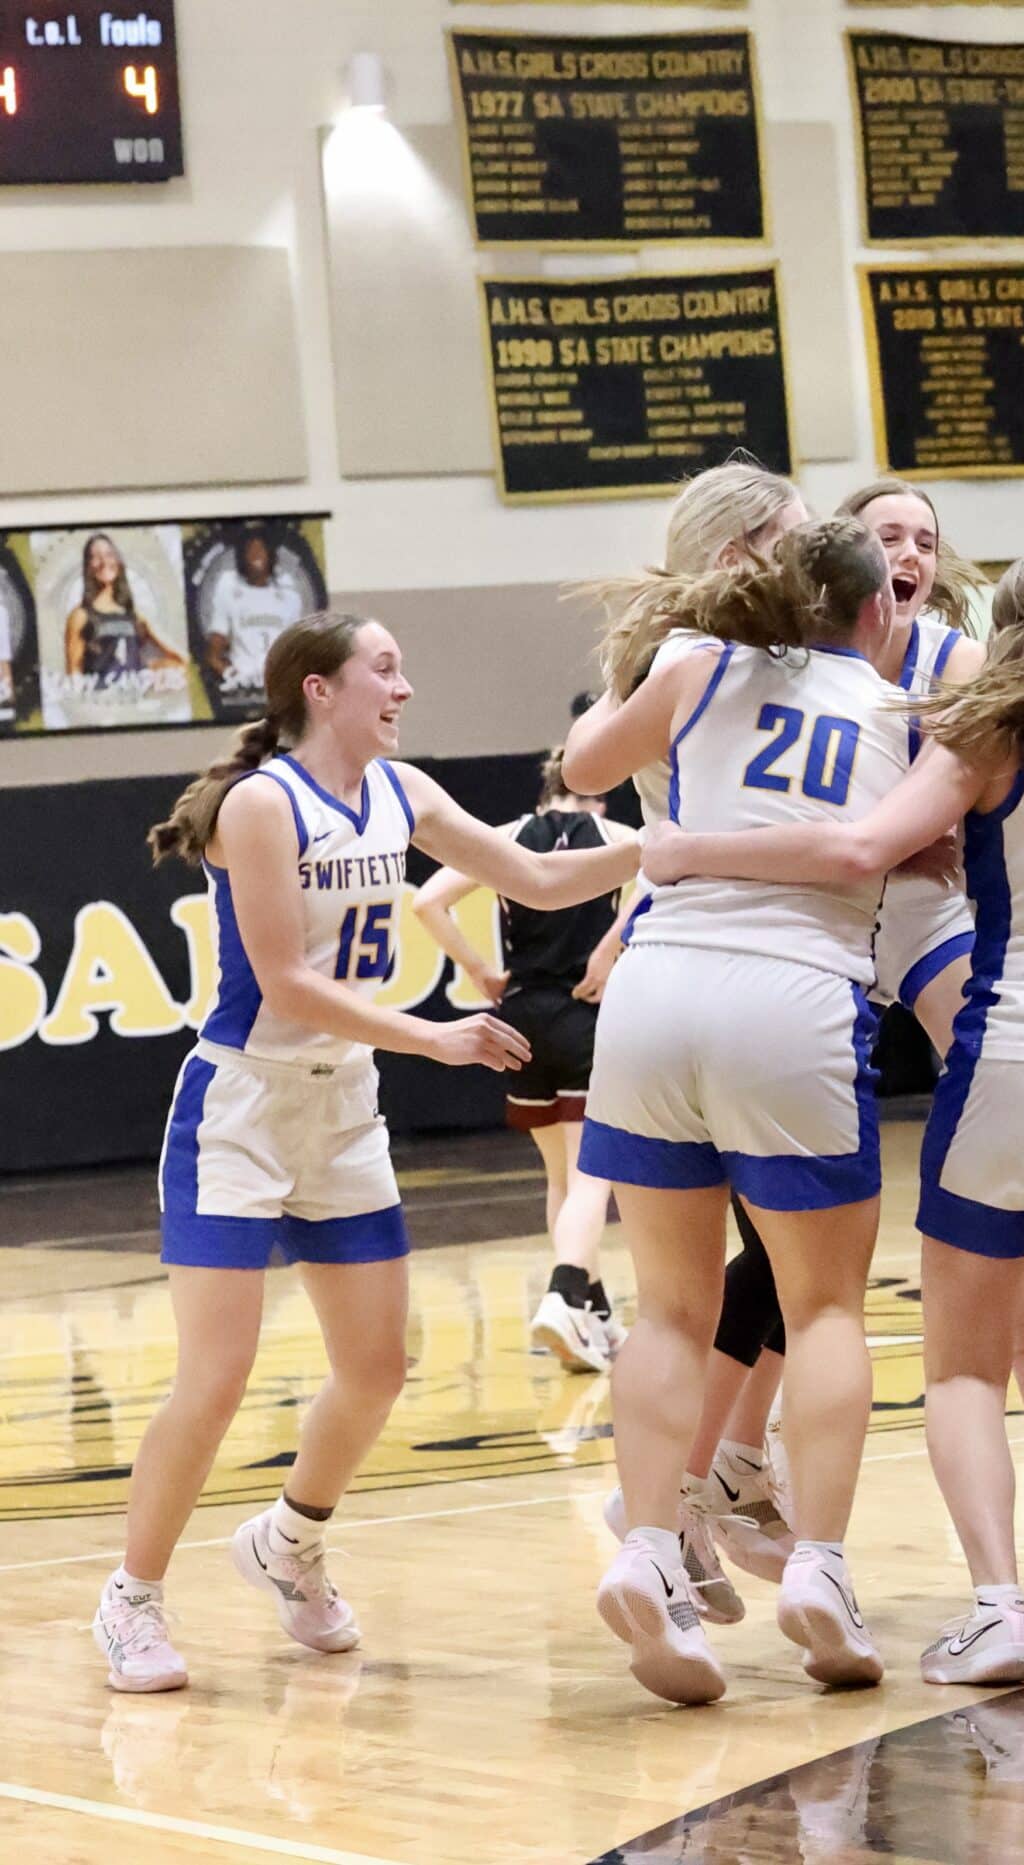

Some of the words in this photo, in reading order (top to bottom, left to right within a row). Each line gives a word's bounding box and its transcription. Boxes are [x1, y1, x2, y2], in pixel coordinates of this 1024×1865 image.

[100, 12, 162, 46] fouls
[515, 52, 577, 80] GIRLS
[579, 52, 649, 79] CROSS
[652, 49, 745, 78] COUNTRY
[124, 65, 158, 115] 4
[469, 90, 524, 118] 1977
[570, 92, 631, 119] STATE
[635, 89, 749, 118] CHAMPIONS
[550, 296, 610, 327] GIRLS
[613, 293, 681, 323] CROSS
[683, 286, 771, 320] COUNTRY
[939, 278, 990, 301] GIRLS
[972, 305, 1024, 328] STATE
[595, 335, 654, 366] STATE
[658, 328, 775, 362] CHAMPIONS
[741, 702, 862, 807] 20
[298, 851, 405, 891] SWIFTETT
[333, 899, 394, 981] 15
